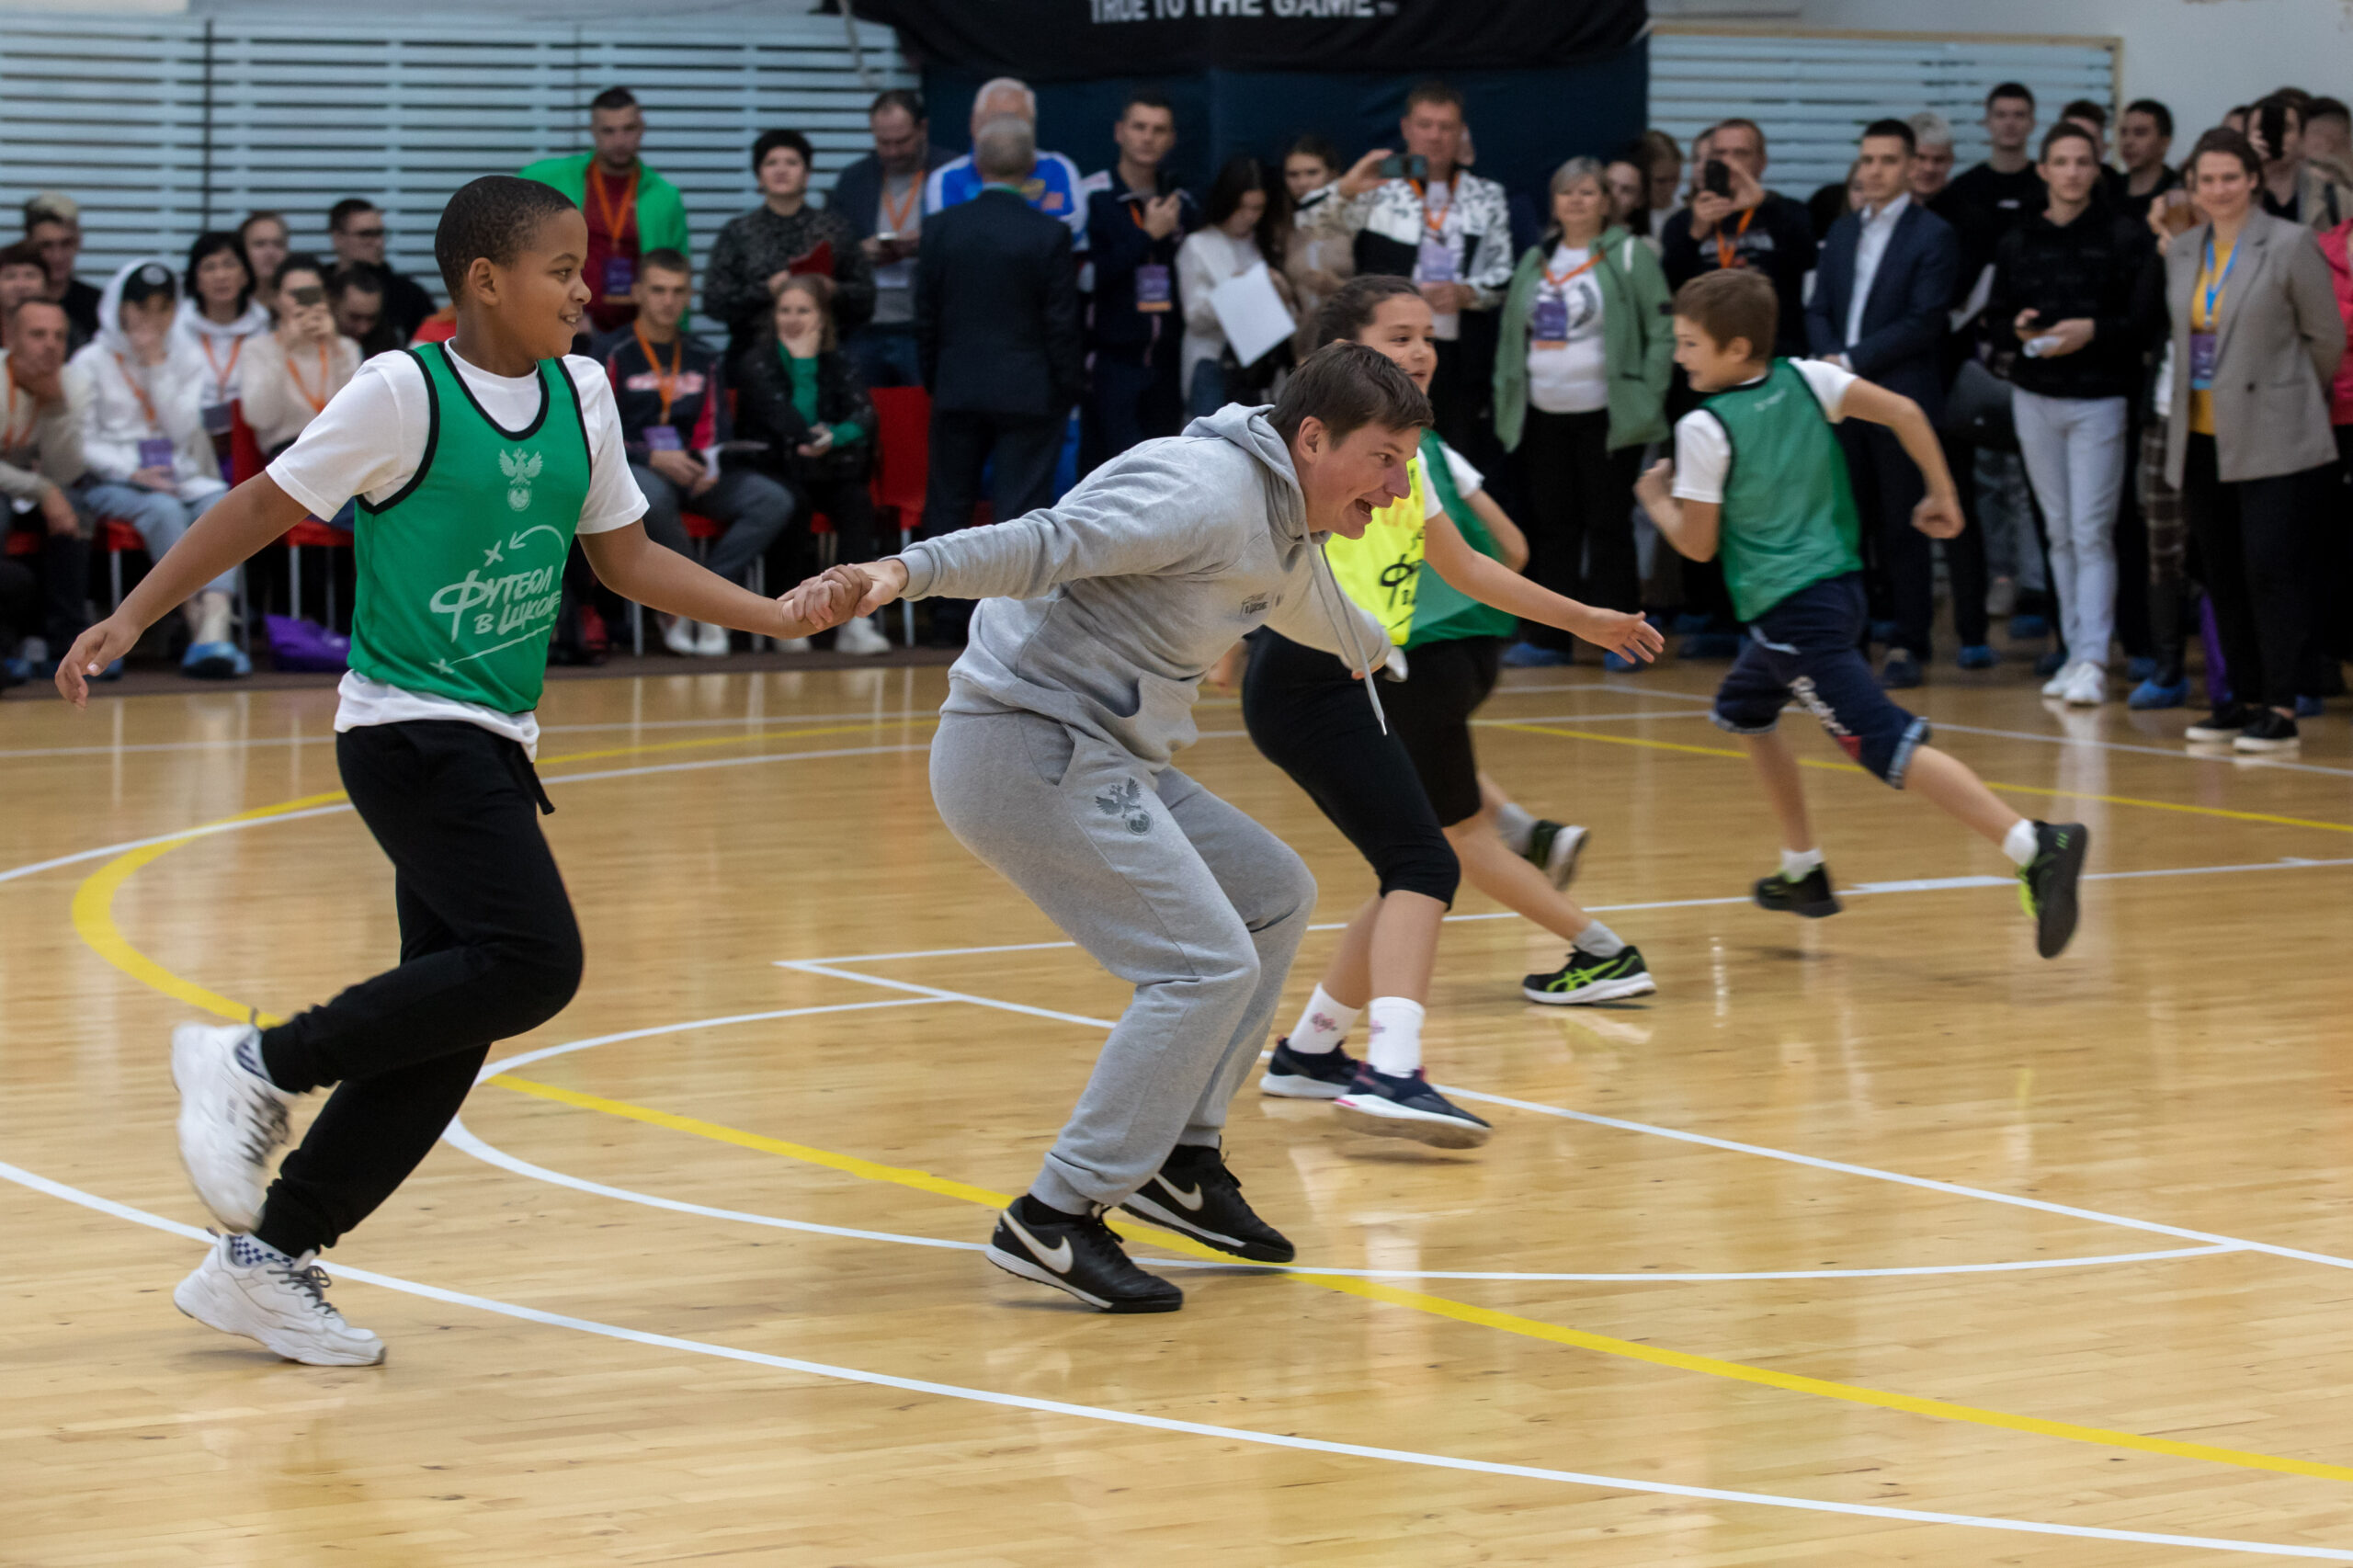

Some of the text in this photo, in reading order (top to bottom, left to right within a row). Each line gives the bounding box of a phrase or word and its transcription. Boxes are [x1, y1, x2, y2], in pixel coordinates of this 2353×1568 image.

[1090, 0, 1148, 23] TRUE
[1193, 0, 1265, 17] THE
[1270, 0, 1375, 17] GAME
